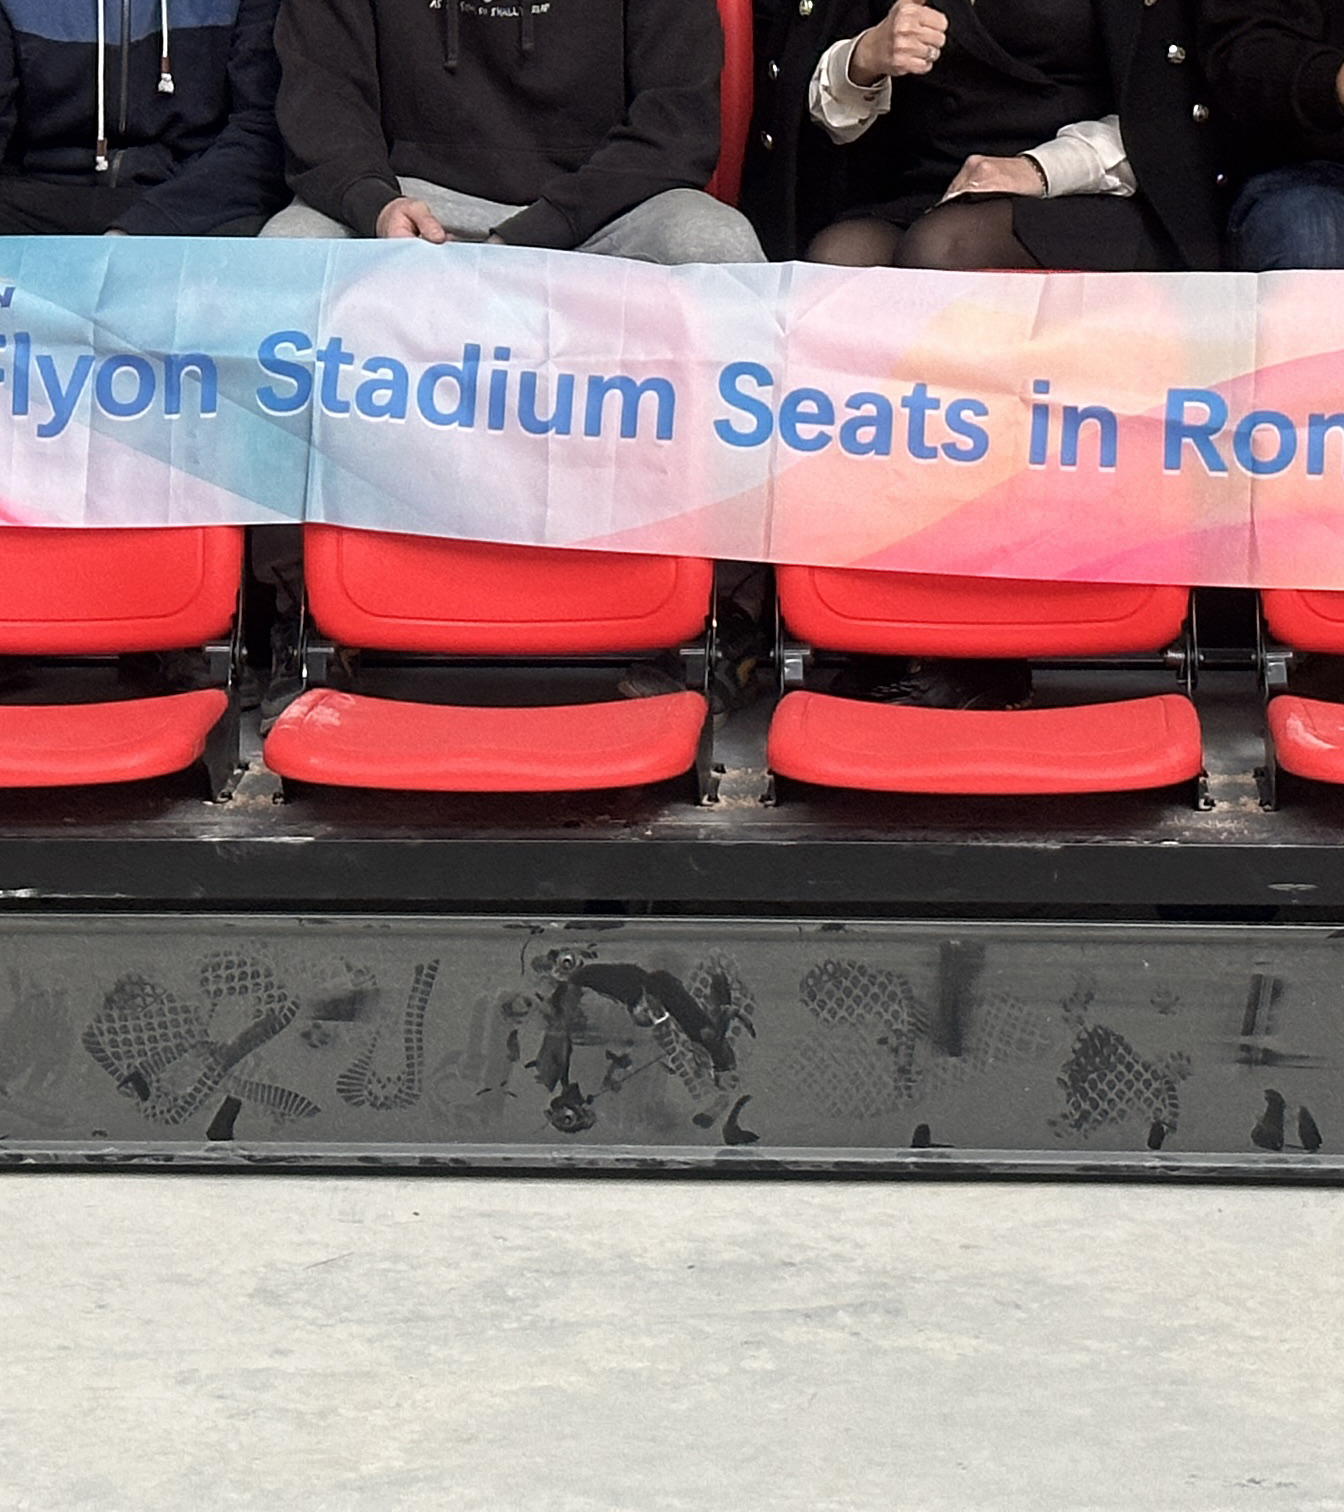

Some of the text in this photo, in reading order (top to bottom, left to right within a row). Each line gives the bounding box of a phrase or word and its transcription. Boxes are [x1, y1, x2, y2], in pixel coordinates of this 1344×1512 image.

[255, 328, 679, 442] Stadium
[712, 359, 990, 464] Seats
[1028, 378, 1118, 470] in
